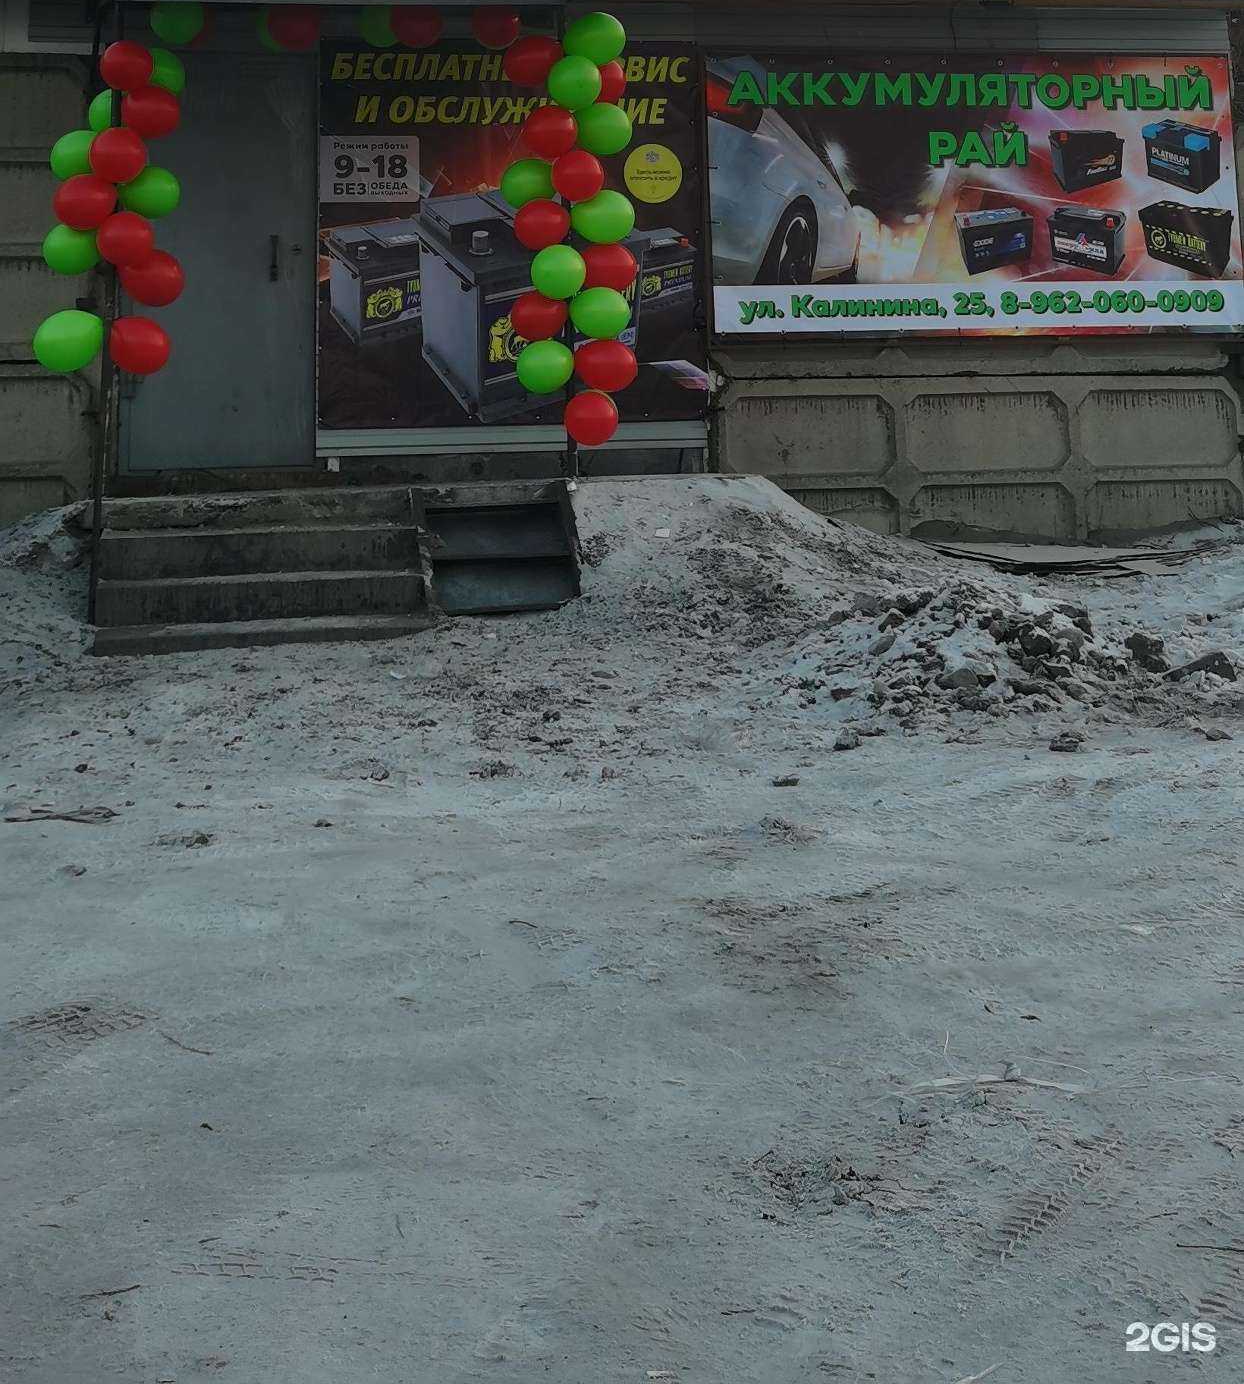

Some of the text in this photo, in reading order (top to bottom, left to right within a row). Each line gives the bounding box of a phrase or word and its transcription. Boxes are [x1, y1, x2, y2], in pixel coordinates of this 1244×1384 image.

[331, 52, 690, 83] БЕСПЛАТН ВИС
[728, 65, 1214, 111] АККУМУЛЯТОРНЫЙ
[354, 95, 668, 126] И ОБСЛУЖИЕ
[371, 142, 408, 151] работы
[928, 120, 1028, 167] РАЙ
[1151, 147, 1190, 165] PLATINUM
[334, 154, 408, 178] 9-18
[333, 182, 408, 195] БЕЗ ОБЕДА
[738, 289, 1225, 325] ул. Калинина, 25, 8-962-060-0909
